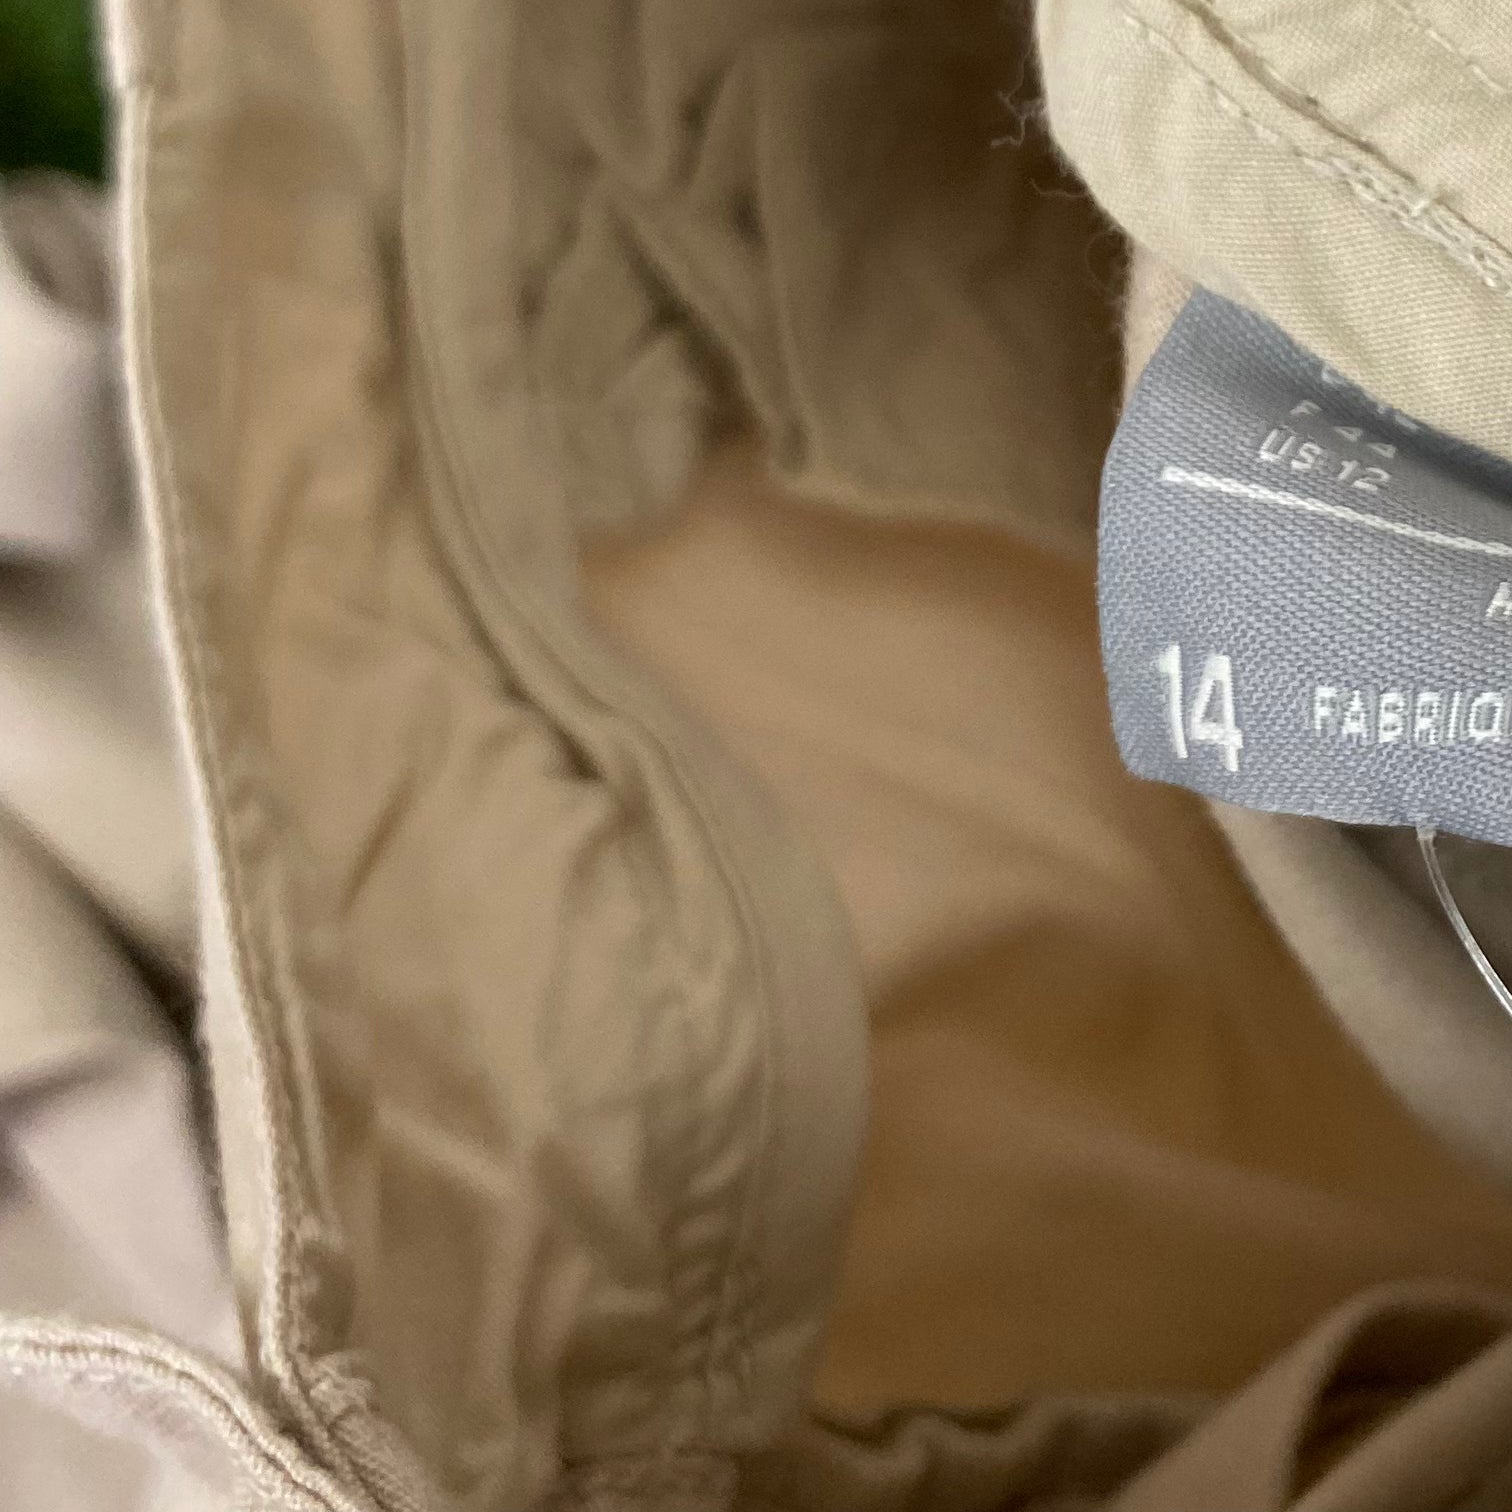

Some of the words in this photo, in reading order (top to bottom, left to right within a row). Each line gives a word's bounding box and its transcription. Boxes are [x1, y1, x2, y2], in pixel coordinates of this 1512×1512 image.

[1259, 428, 1324, 470] US
[1337, 459, 1392, 491] 12
[1153, 641, 1244, 773] 14
